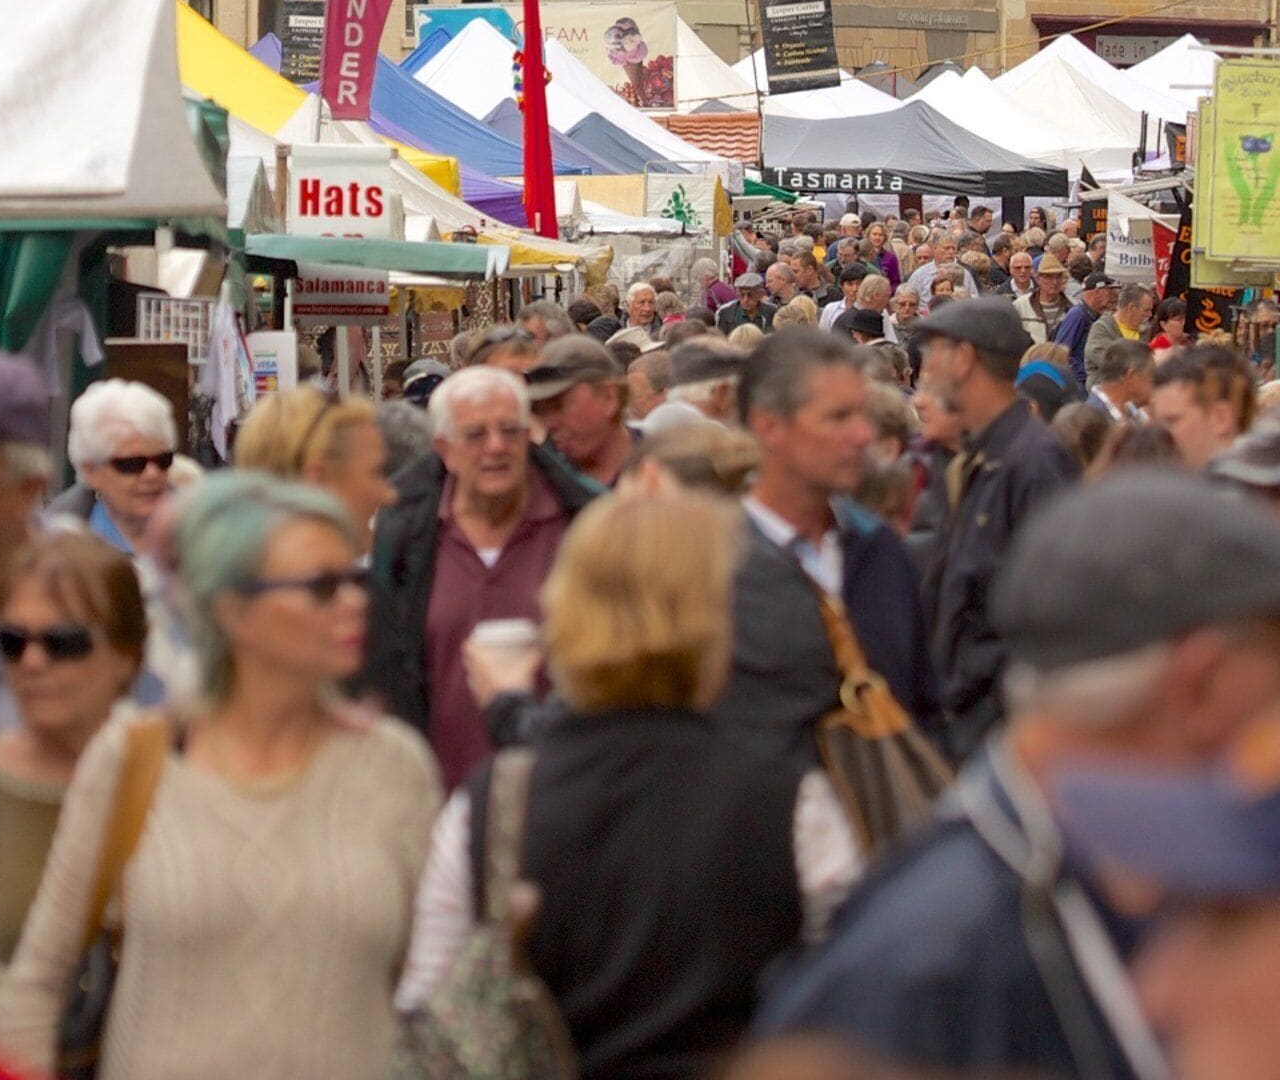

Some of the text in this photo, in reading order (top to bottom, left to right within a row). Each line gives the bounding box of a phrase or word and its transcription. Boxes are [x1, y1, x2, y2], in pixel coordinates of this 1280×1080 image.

[1098, 39, 1125, 58] Made
[1133, 41, 1145, 58] in
[773, 167, 903, 190] Tasmania
[299, 178, 384, 218] Hats
[295, 277, 385, 295] Salamanca
